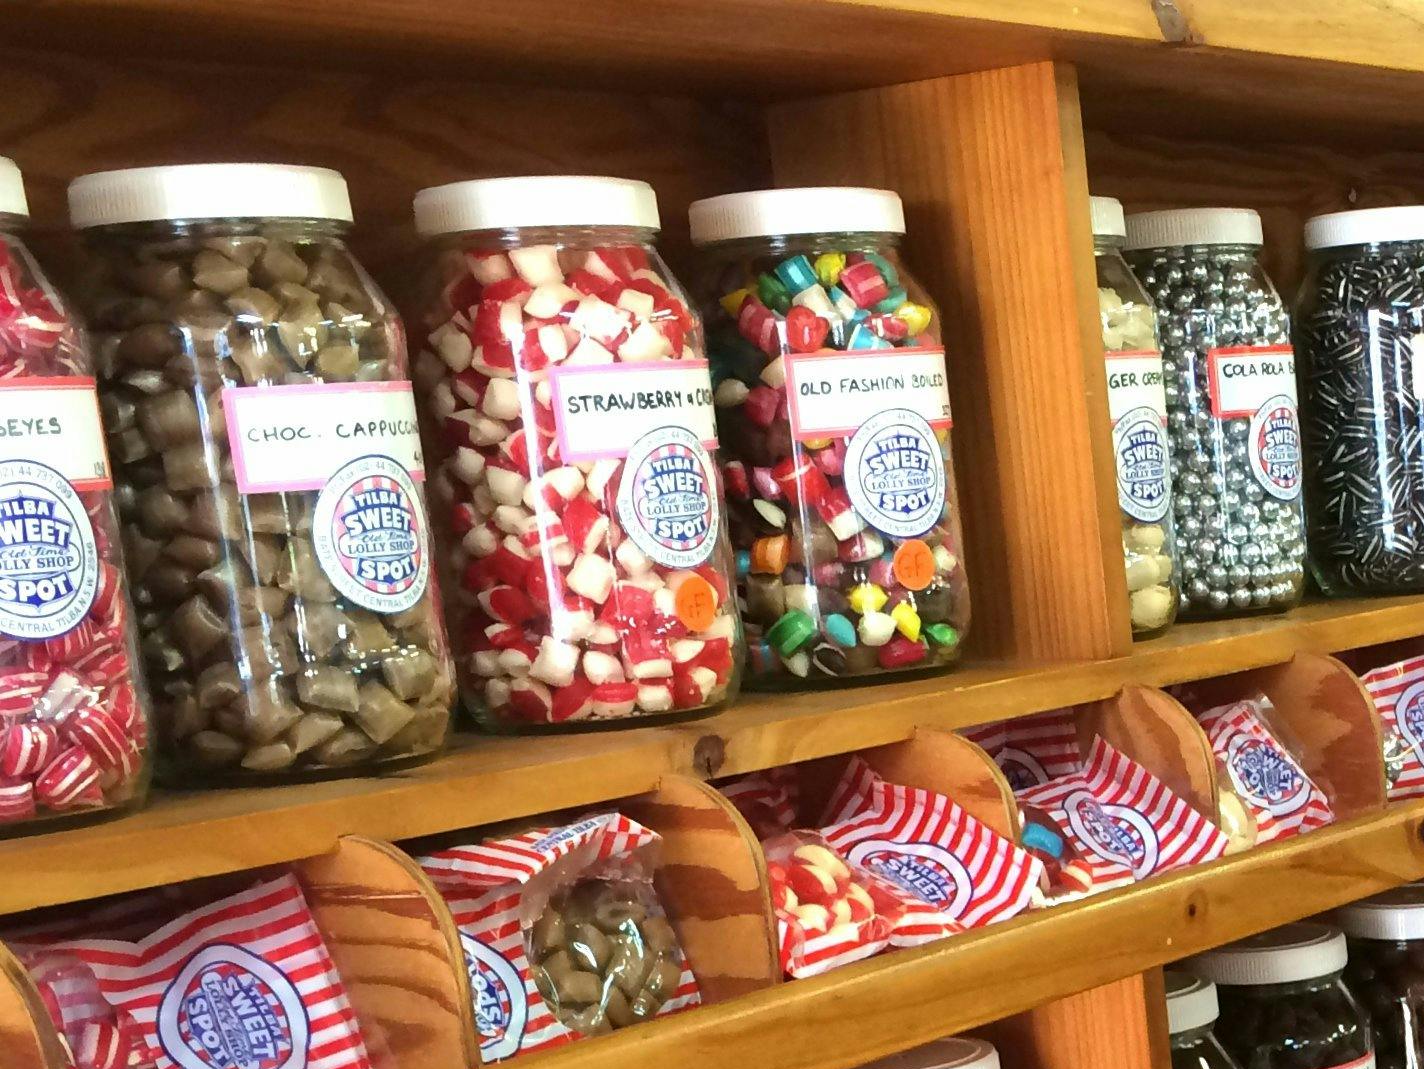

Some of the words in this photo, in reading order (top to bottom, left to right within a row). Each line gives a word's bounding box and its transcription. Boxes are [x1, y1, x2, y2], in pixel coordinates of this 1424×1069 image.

[1108, 372, 1138, 389] GER
[1222, 362, 1258, 378] COLA
[800, 381, 832, 396] OLD
[840, 374, 905, 394] FASHION
[567, 390, 683, 413] STRAWBERRY
[879, 436, 917, 452] TILBA
[1130, 432, 1157, 444] TILBA
[1265, 429, 1297, 449] SWEET
[652, 456, 693, 472] TILBA
[868, 453, 930, 476] SWEET
[1124, 444, 1164, 465] SWEET
[907, 476, 932, 487] SHOP
[1271, 464, 1297, 478] SPOT
[643, 473, 705, 499] SWEET
[1131, 480, 1165, 498] SPOT
[353, 490, 398, 508] TILBA
[645, 503, 680, 515] LOLLY
[683, 501, 709, 513] SHOP
[881, 491, 929, 512] SPOT
[344, 506, 412, 538] SWEET
[658, 519, 704, 540] SPOT
[0, 521, 71, 547] WEET
[347, 541, 386, 555] LOLLY
[389, 539, 416, 552] SHOP
[36, 555, 75, 569] SHOP
[361, 557, 415, 582] SPOT
[0, 574, 70, 603] SPOT
[887, 858, 948, 902] SWEET
[222, 976, 277, 1059] SWEET
[188, 997, 231, 1065] SPOT
